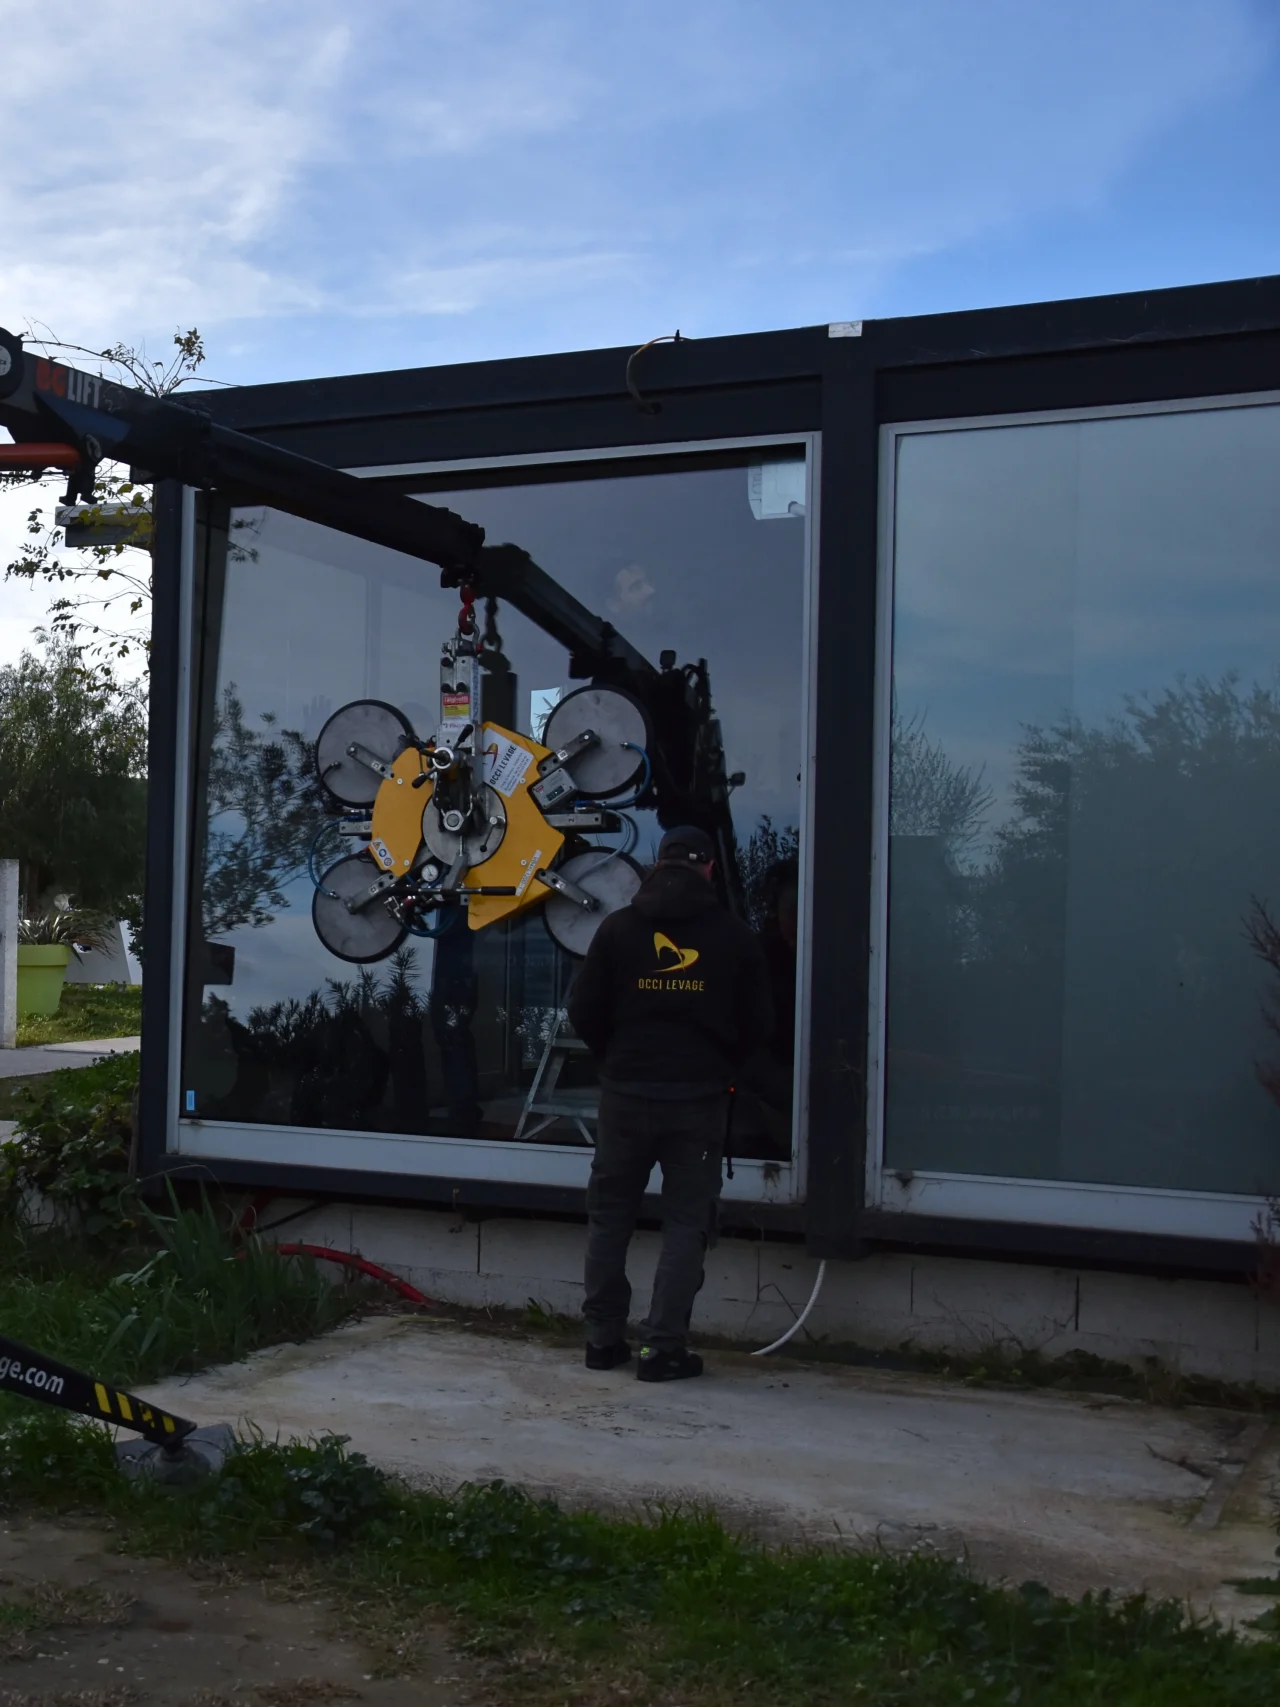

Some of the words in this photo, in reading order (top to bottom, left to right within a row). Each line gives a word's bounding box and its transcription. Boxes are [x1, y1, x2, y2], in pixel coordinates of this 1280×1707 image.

[67, 368, 103, 409] LIFT
[489, 768, 503, 785] OCCI
[499, 744, 517, 769] LEVAGE
[638, 978, 663, 990] OCCI
[666, 979, 705, 991] LEVAGE
